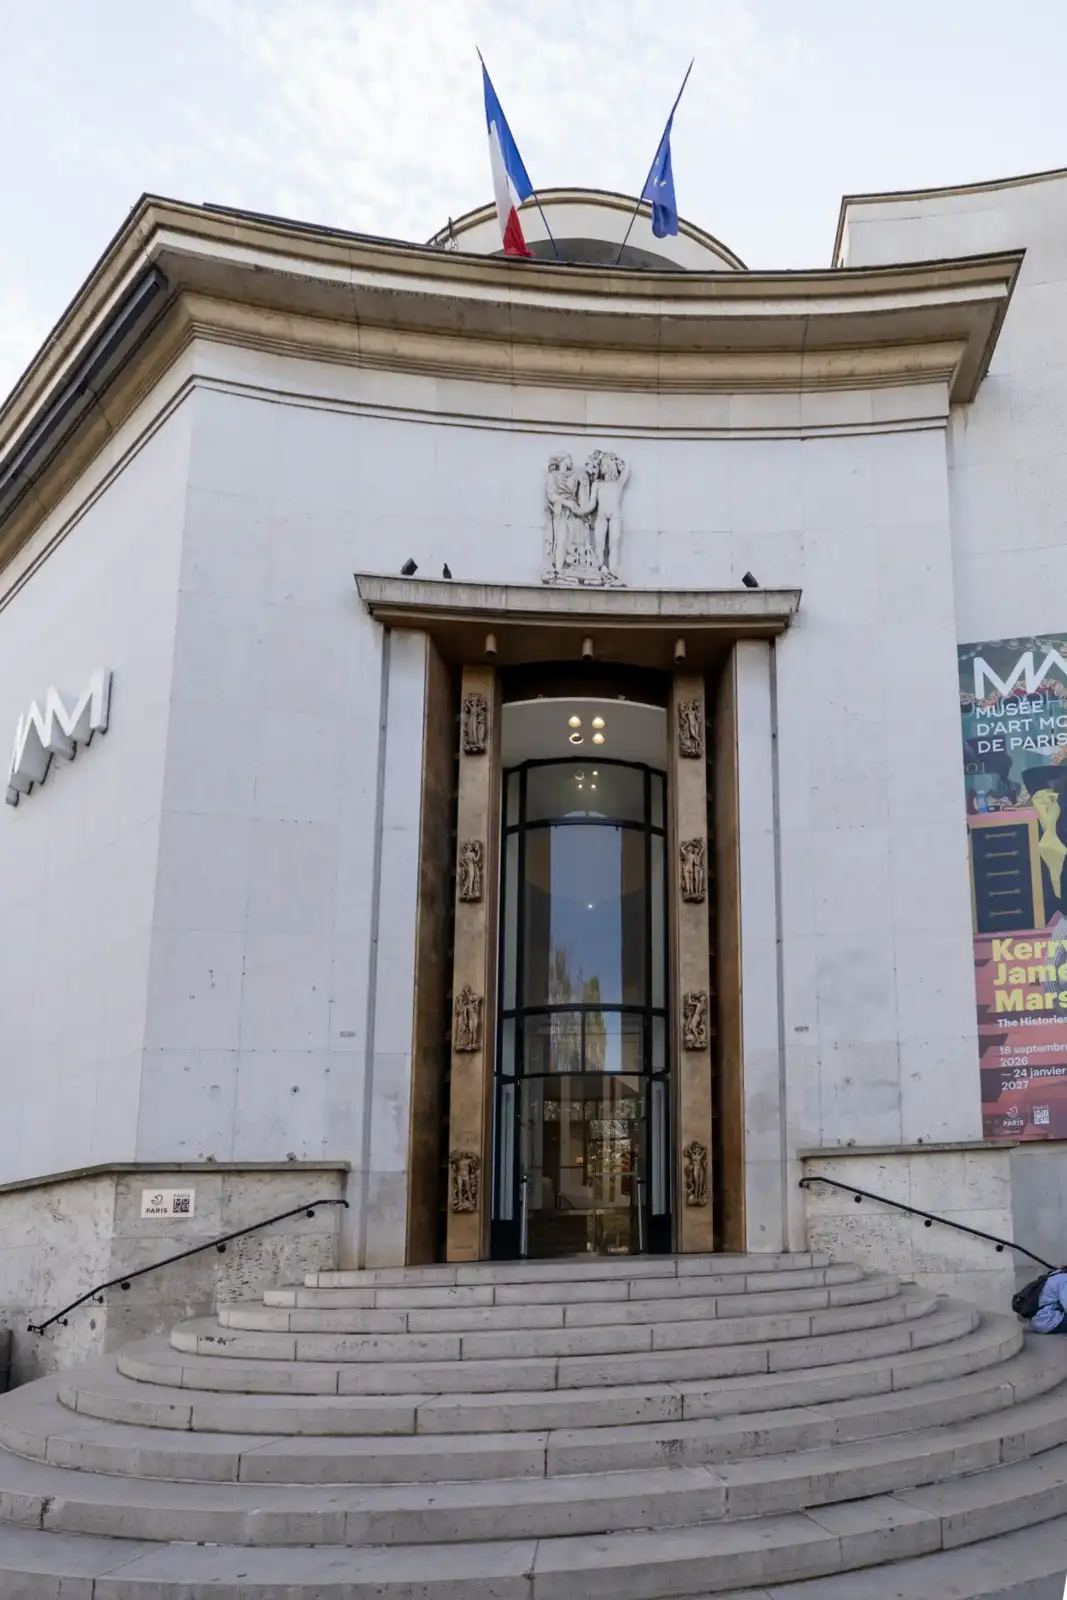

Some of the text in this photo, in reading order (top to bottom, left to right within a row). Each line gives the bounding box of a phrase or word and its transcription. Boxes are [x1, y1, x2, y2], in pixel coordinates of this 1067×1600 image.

[976, 698, 1044, 719] MUSÉE
[977, 719, 1032, 736] D'ART
[978, 733, 1067, 753] DE PARIS
[997, 1018, 1019, 1028] The
[1000, 1056, 1028, 1067] 2026
[1013, 1068, 1027, 1078] 24
[1029, 1066, 1067, 1078] janvier
[1001, 1080, 1028, 1091] 2027
